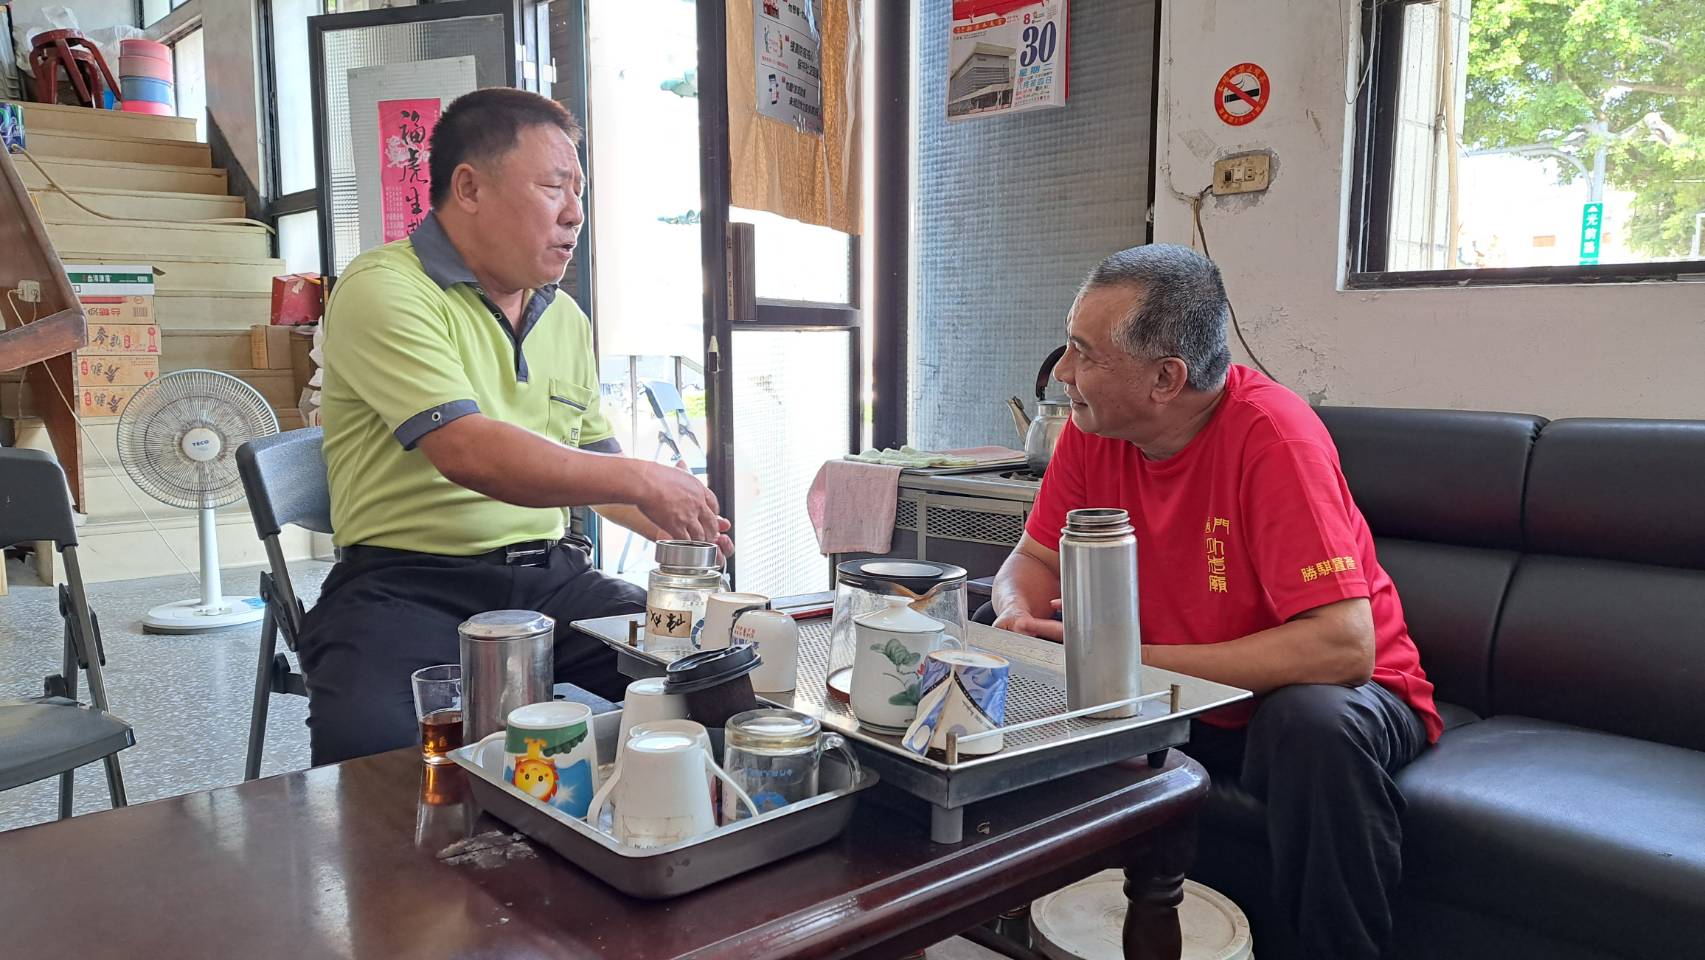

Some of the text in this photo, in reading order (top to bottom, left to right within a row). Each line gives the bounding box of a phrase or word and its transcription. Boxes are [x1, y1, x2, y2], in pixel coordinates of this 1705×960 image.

[1023, 13, 1031, 24] 8
[1020, 21, 1057, 67] 30
[84, 306, 121, 317] 台糖沙
[191, 439, 209, 447] TECO
